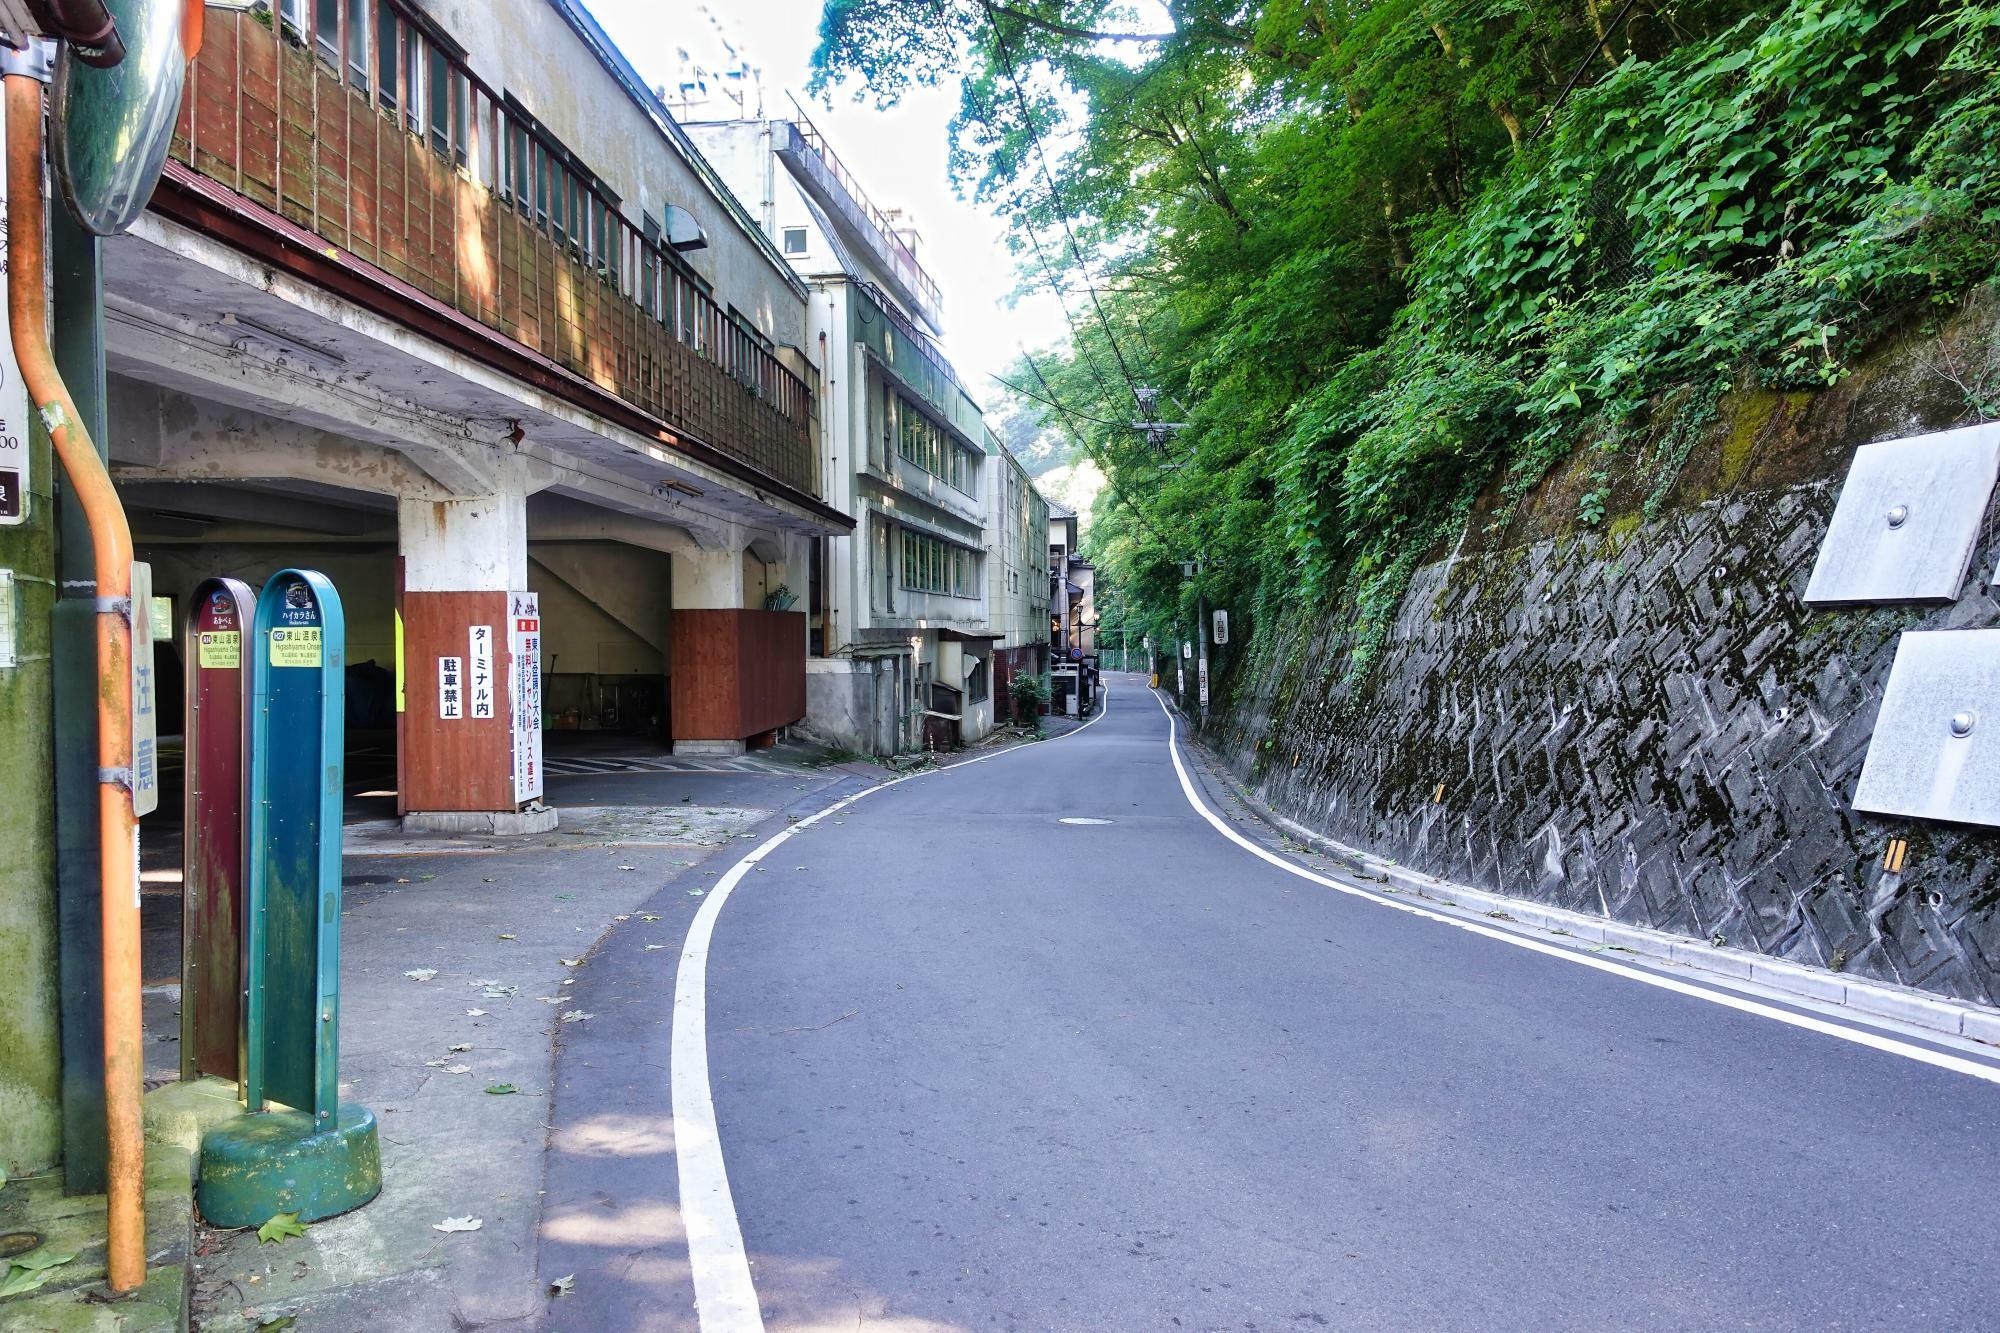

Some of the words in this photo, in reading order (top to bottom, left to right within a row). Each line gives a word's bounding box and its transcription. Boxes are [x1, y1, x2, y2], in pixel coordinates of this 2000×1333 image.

[282, 611, 316, 619] ハイカラさん
[443, 659, 458, 717] 駐車禁止
[475, 627, 489, 716] ターミナル内
[136, 663, 153, 794] 注意
